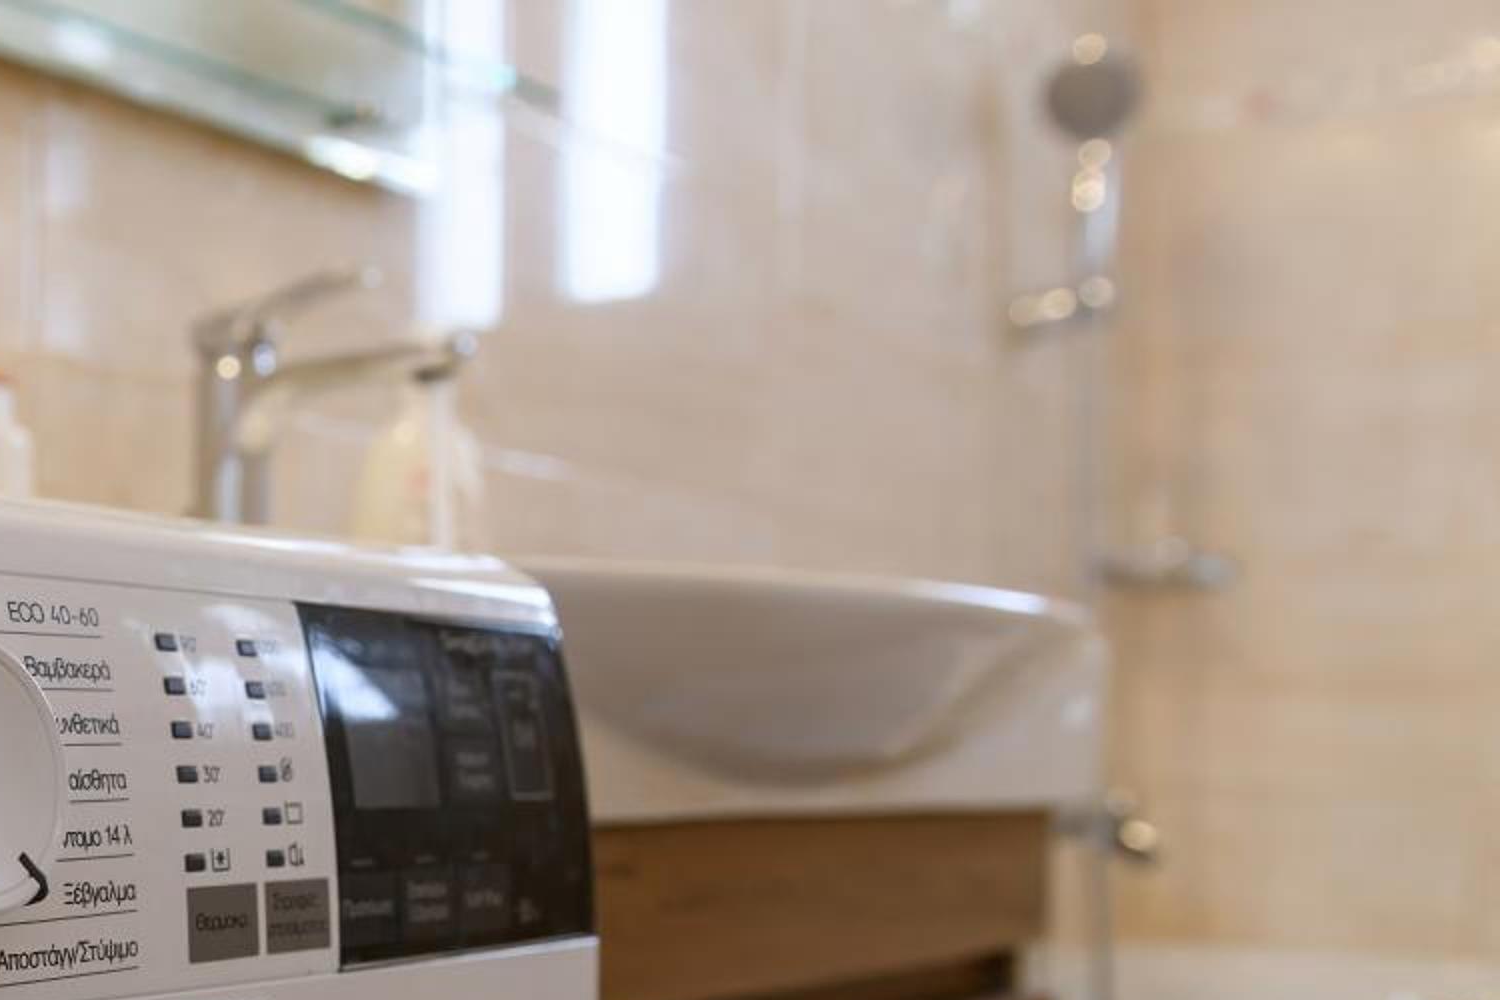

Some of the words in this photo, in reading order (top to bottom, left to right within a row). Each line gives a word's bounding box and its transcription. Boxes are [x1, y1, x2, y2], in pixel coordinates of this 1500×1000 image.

[7, 601, 44, 624] ECO
[51, 604, 99, 627] 40-60
[24, 655, 111, 682] Βαμβακερά
[104, 824, 121, 846] 14
[63, 880, 138, 908] Ξέβγαλμα
